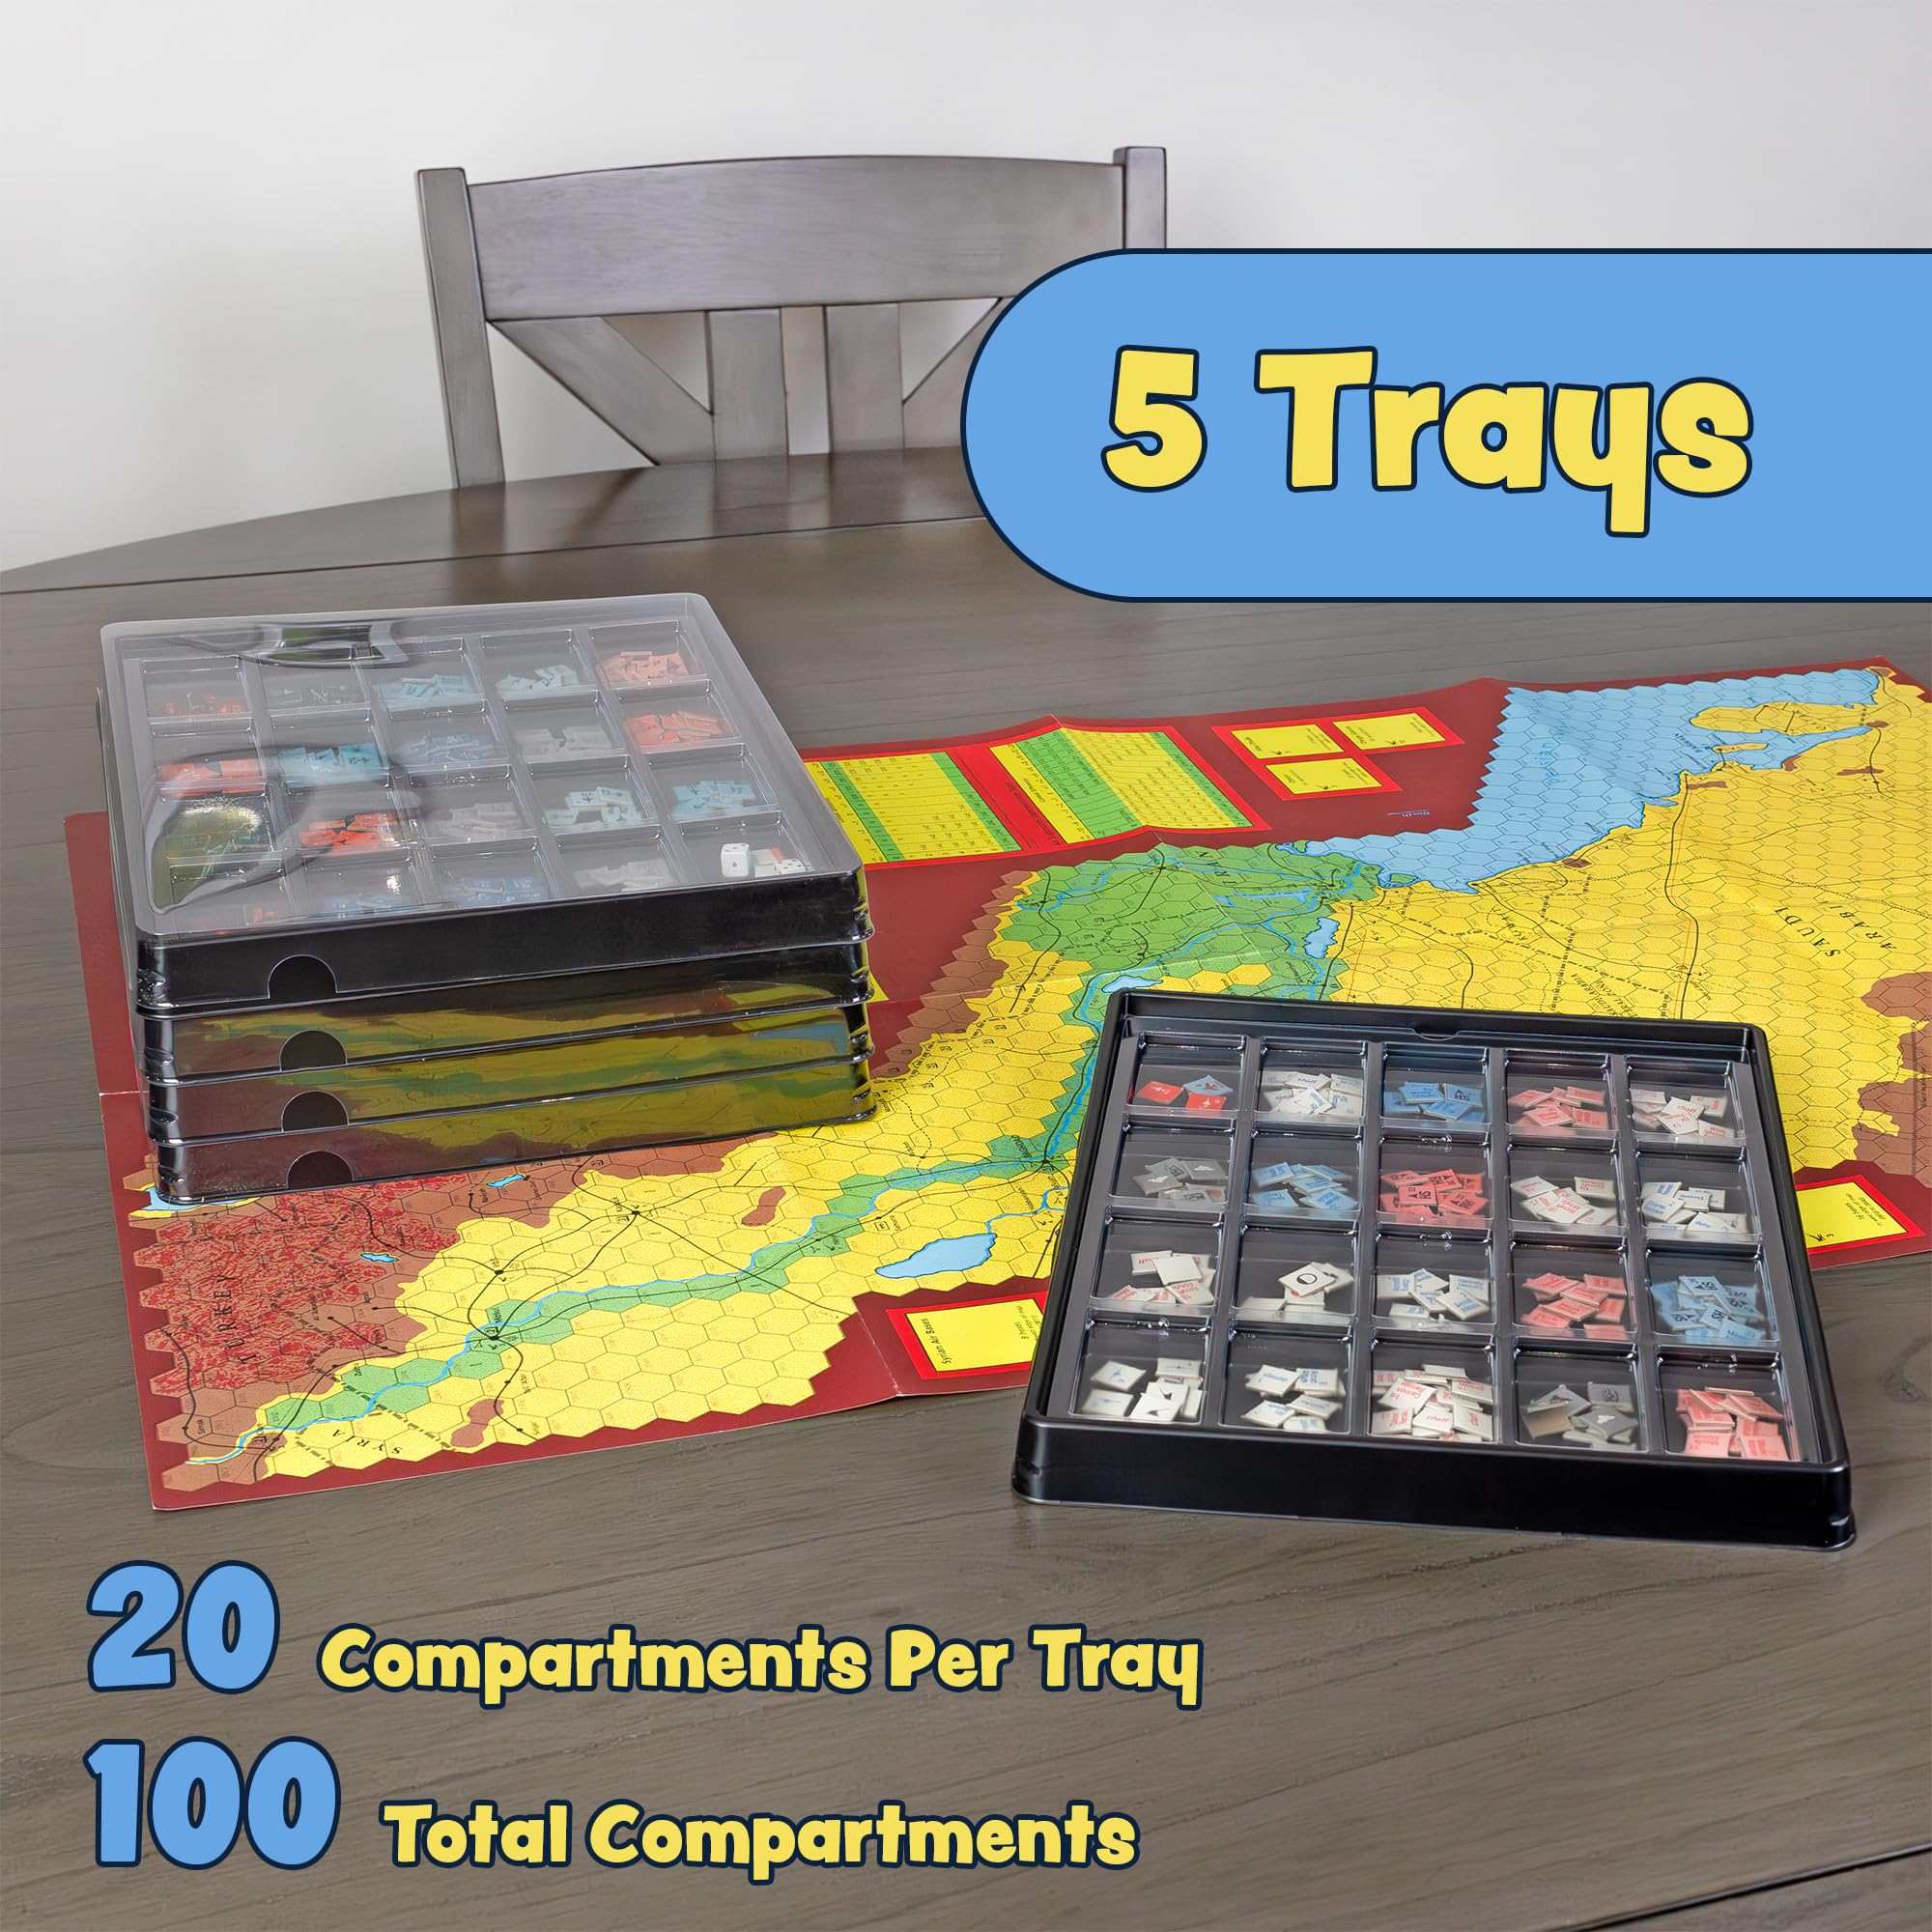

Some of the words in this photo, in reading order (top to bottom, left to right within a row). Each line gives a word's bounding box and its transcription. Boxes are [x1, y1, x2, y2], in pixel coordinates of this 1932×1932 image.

[1775, 906, 1841, 957] SAUDI
[213, 1273, 259, 1365] TURKEY
[921, 1318, 935, 1335] Bases
[936, 1346, 952, 1364] Syrian
[330, 1428, 404, 1456] SYRIA
